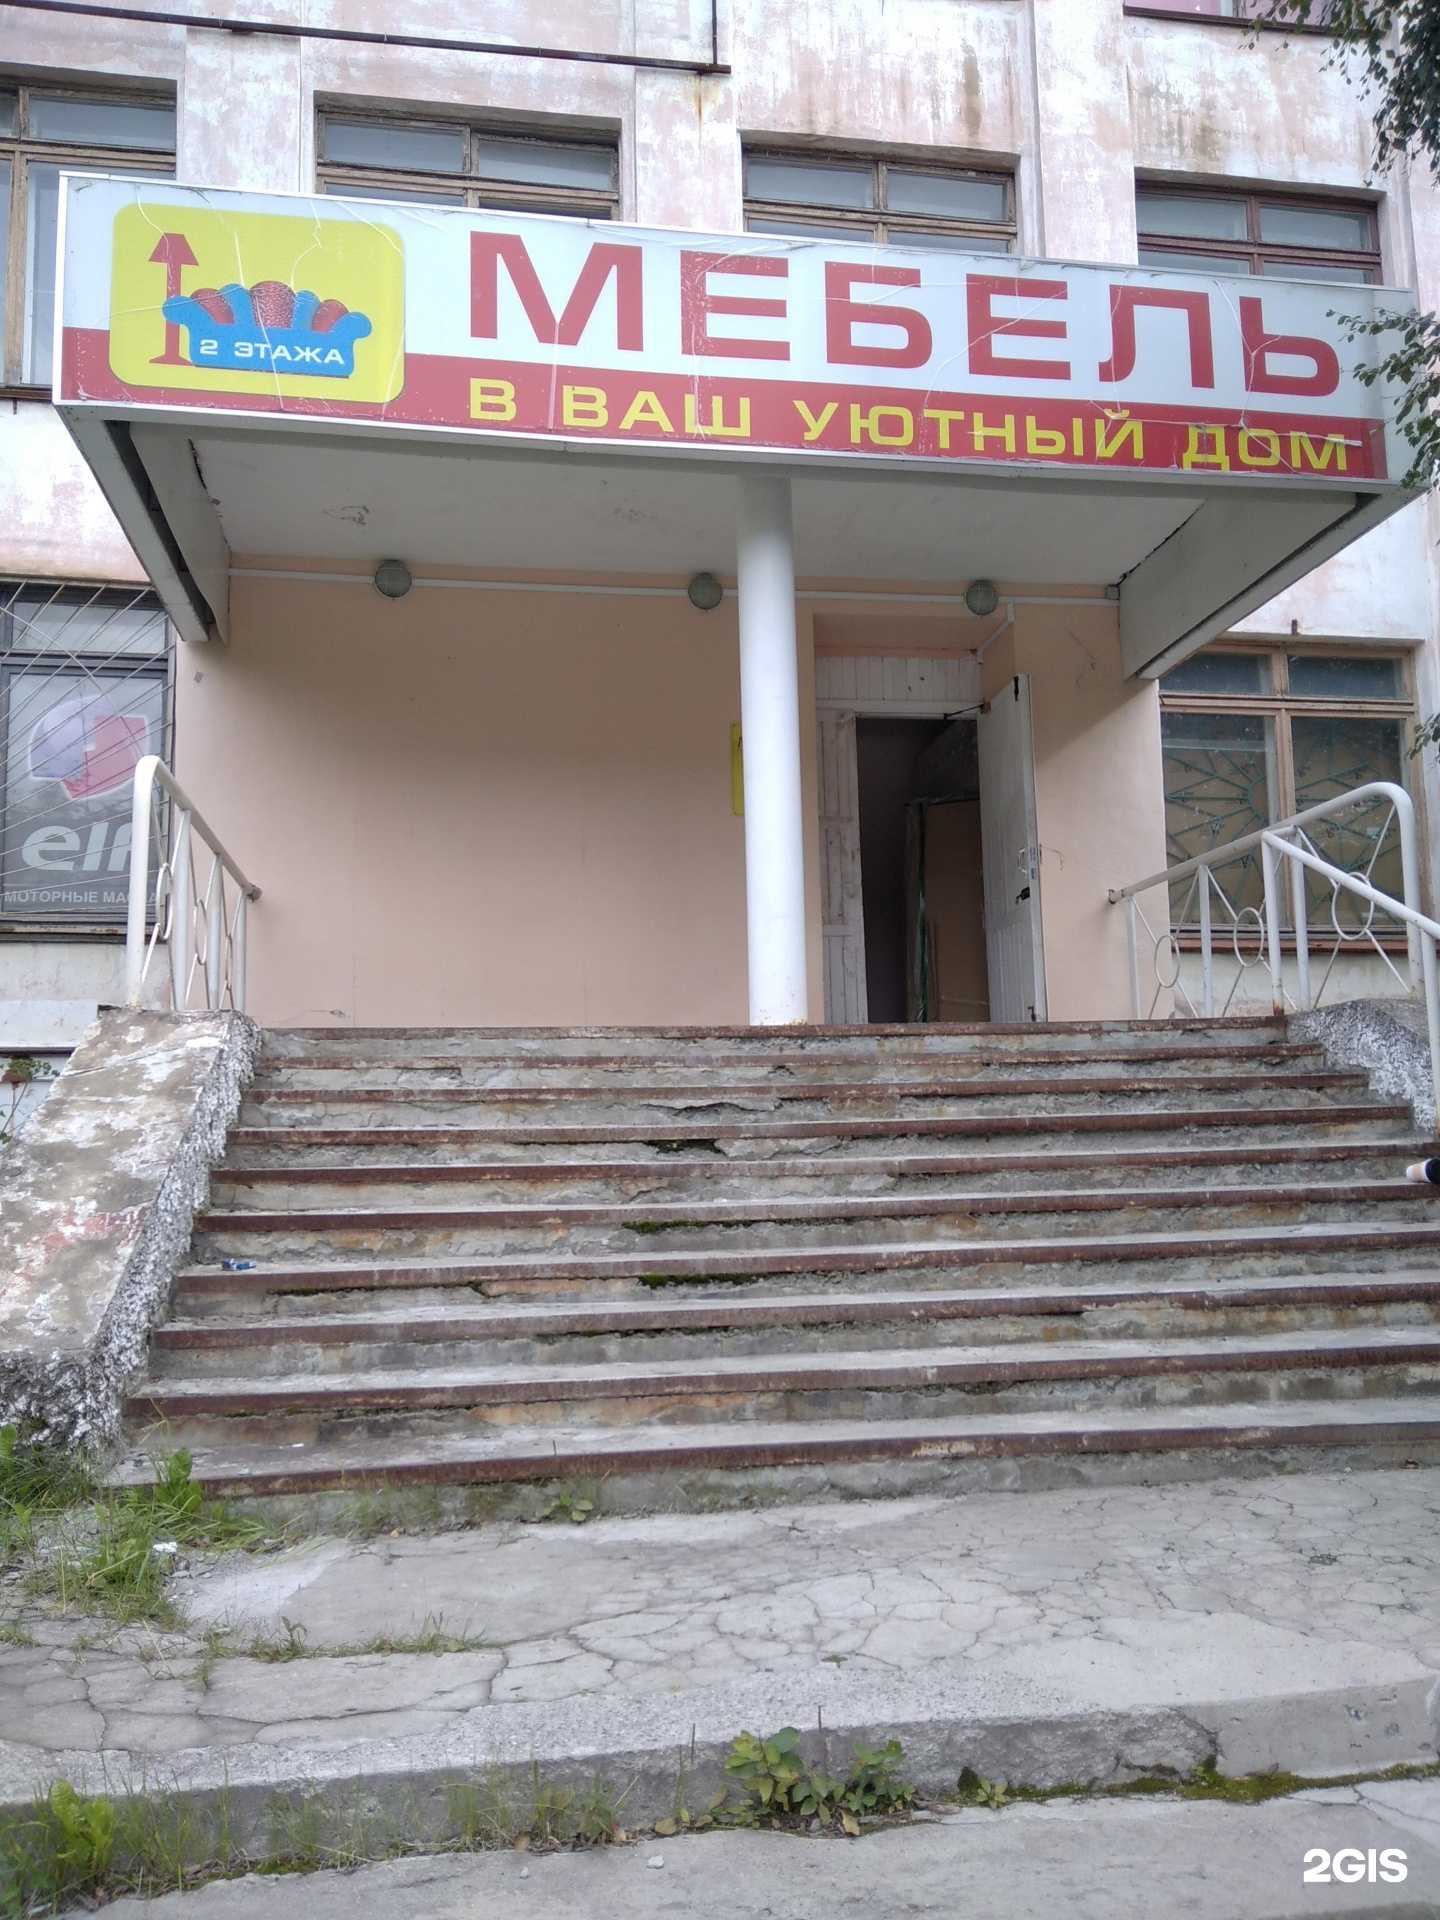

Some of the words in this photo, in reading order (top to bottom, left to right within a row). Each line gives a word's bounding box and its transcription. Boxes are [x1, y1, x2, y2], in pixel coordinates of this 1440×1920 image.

[470, 231, 1340, 397] МЕБЕЛЬ
[200, 339, 218, 355] 2
[234, 341, 345, 365] ЭТАЖА
[469, 377, 517, 422] В
[562, 384, 751, 437] ВАШ
[793, 400, 1144, 460] УЮТНЫЙ
[1182, 424, 1348, 472] ДОМ
[4, 890, 98, 904] МОТОРНЫЕ
[103, 891, 157, 904] МАА
